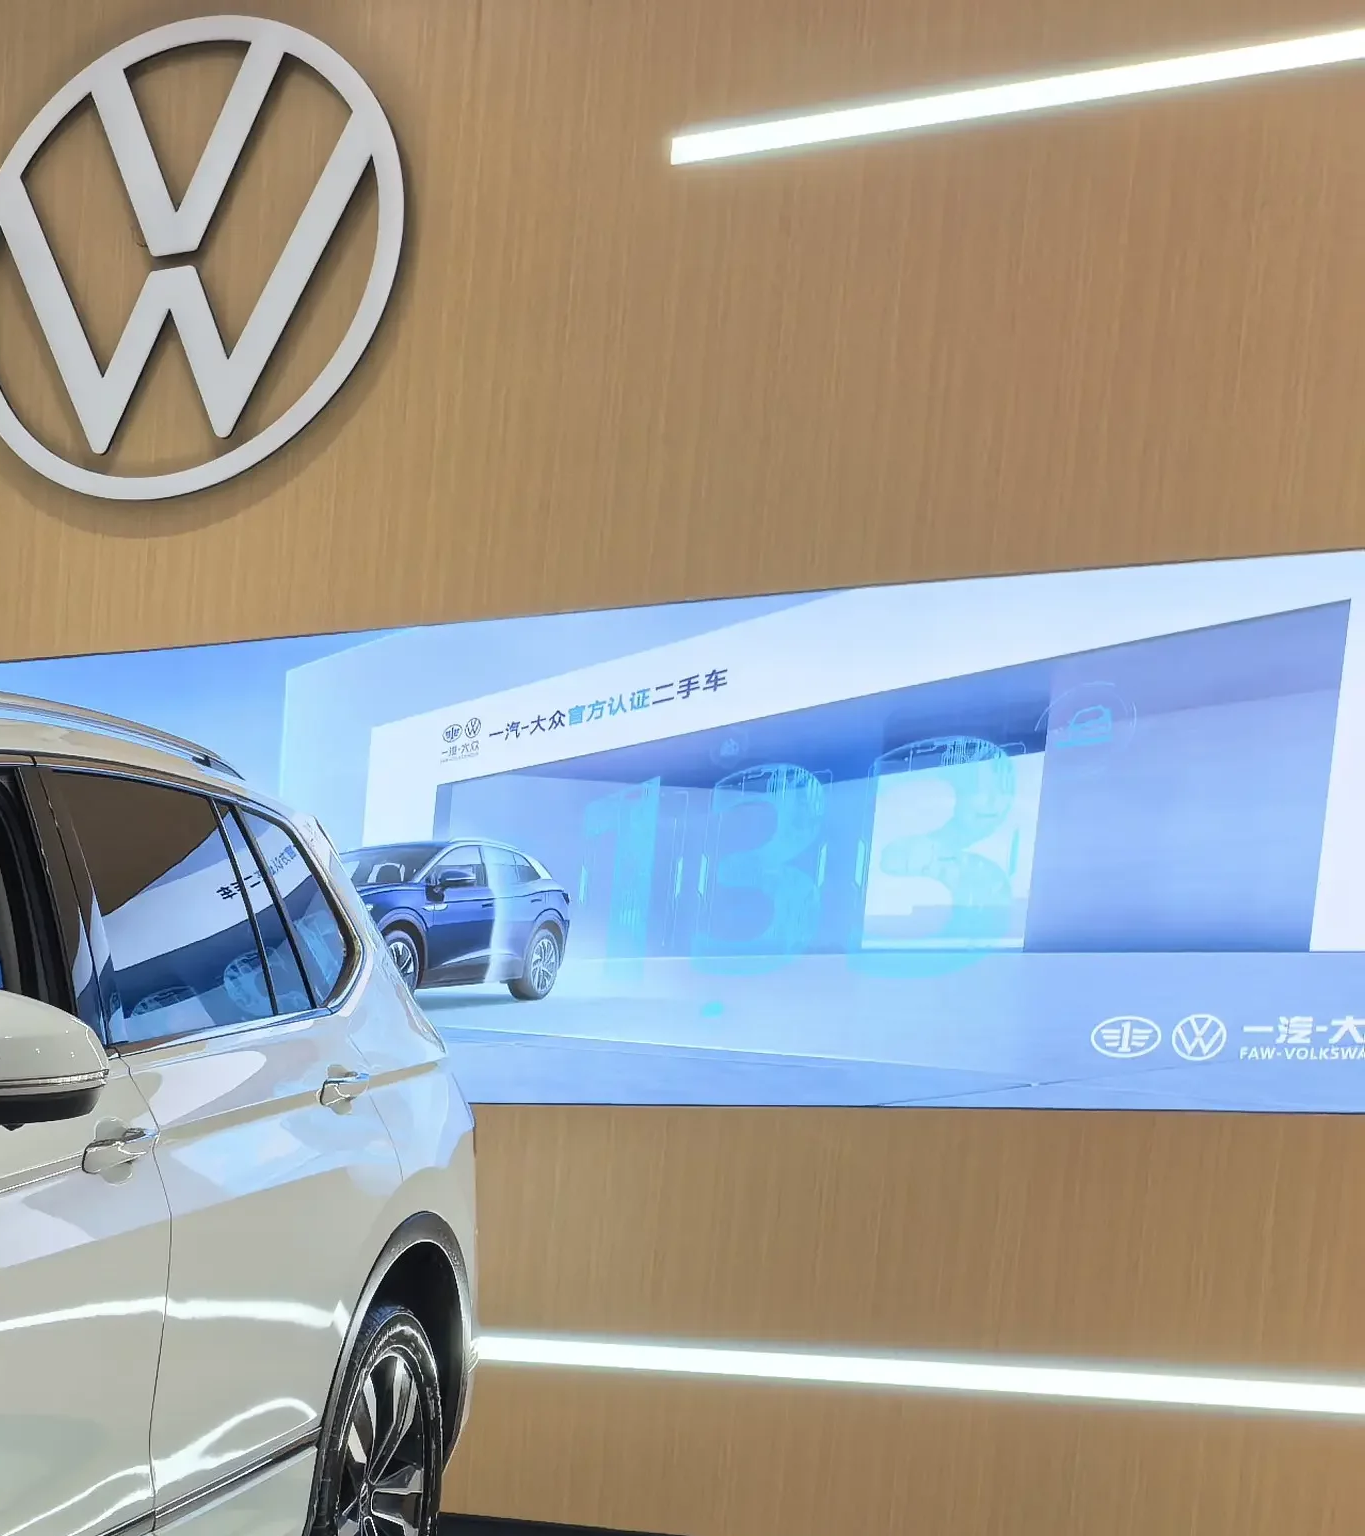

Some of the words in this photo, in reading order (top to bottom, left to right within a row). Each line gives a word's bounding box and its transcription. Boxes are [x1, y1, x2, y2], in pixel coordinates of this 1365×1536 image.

[488, 668, 729, 742] 一汽-大众官方认证二手车
